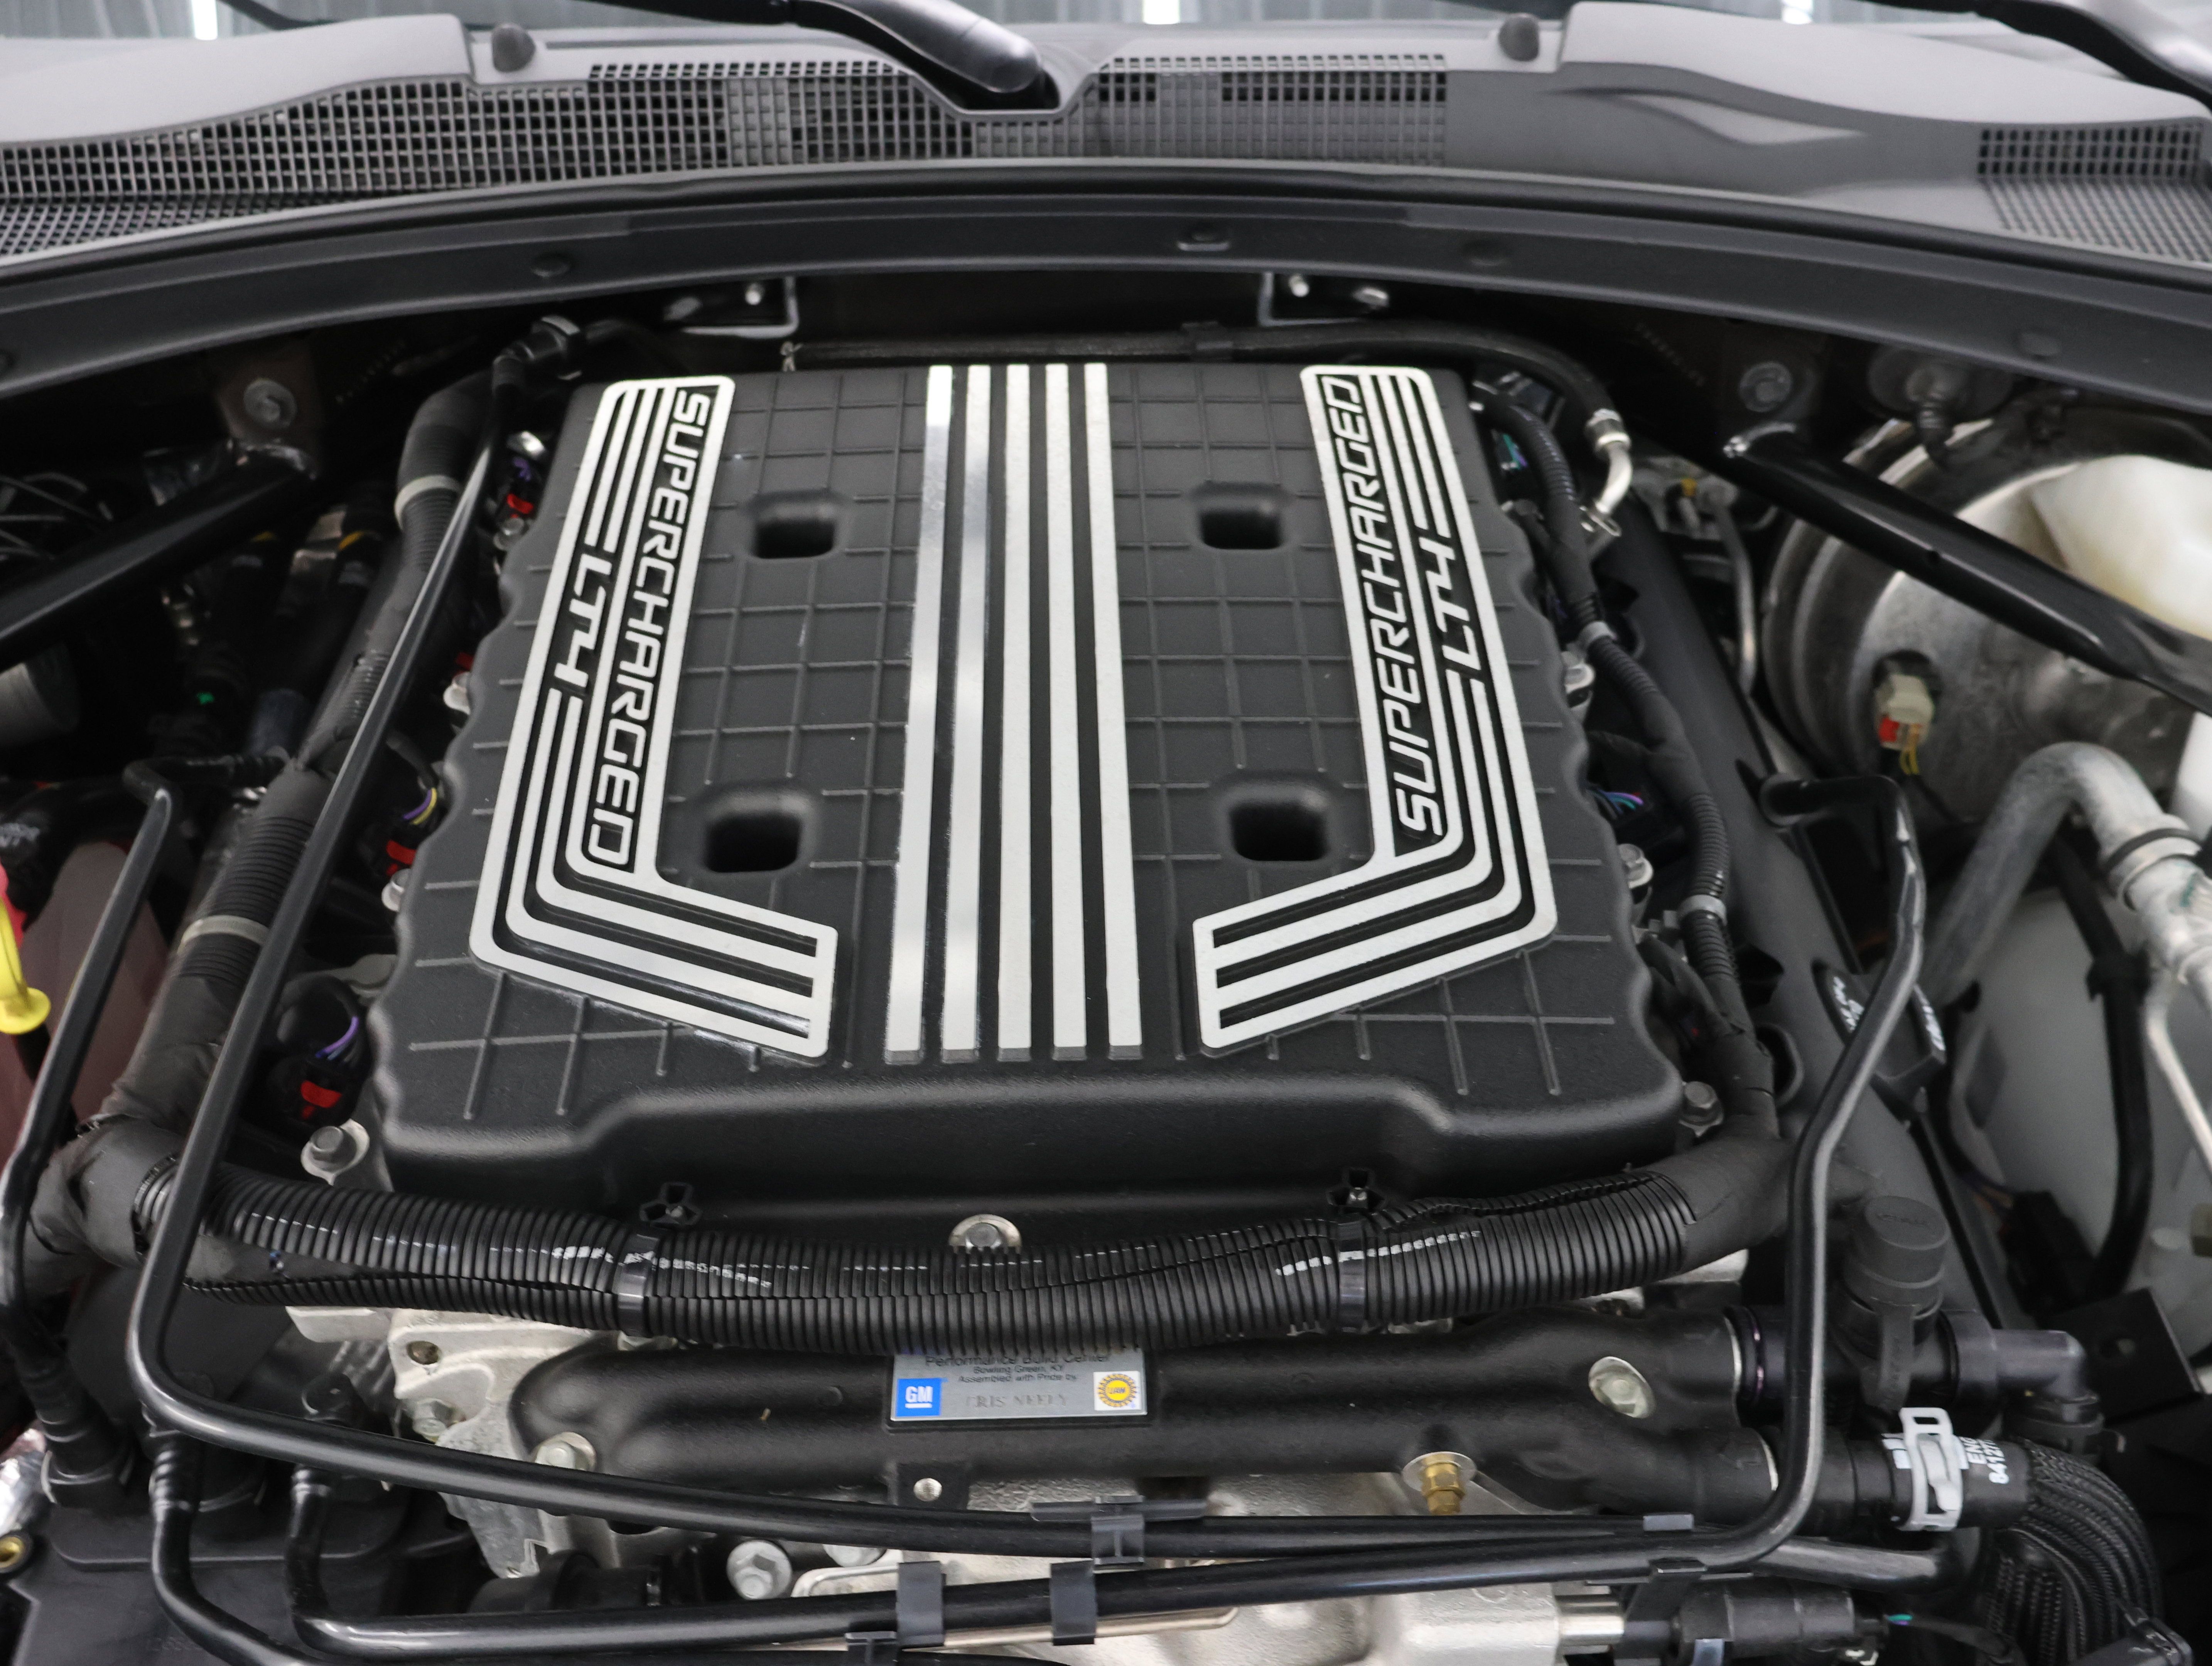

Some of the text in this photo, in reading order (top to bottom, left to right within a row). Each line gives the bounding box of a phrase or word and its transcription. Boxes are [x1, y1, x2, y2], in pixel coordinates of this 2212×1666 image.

[553, 553, 612, 688] LT4
[587, 389, 711, 865] SUPERCHARGED
[1320, 375, 1443, 836] SUPERCHARGED
[1418, 537, 1482, 670] LT4
[905, 1386, 933, 1403] GM
